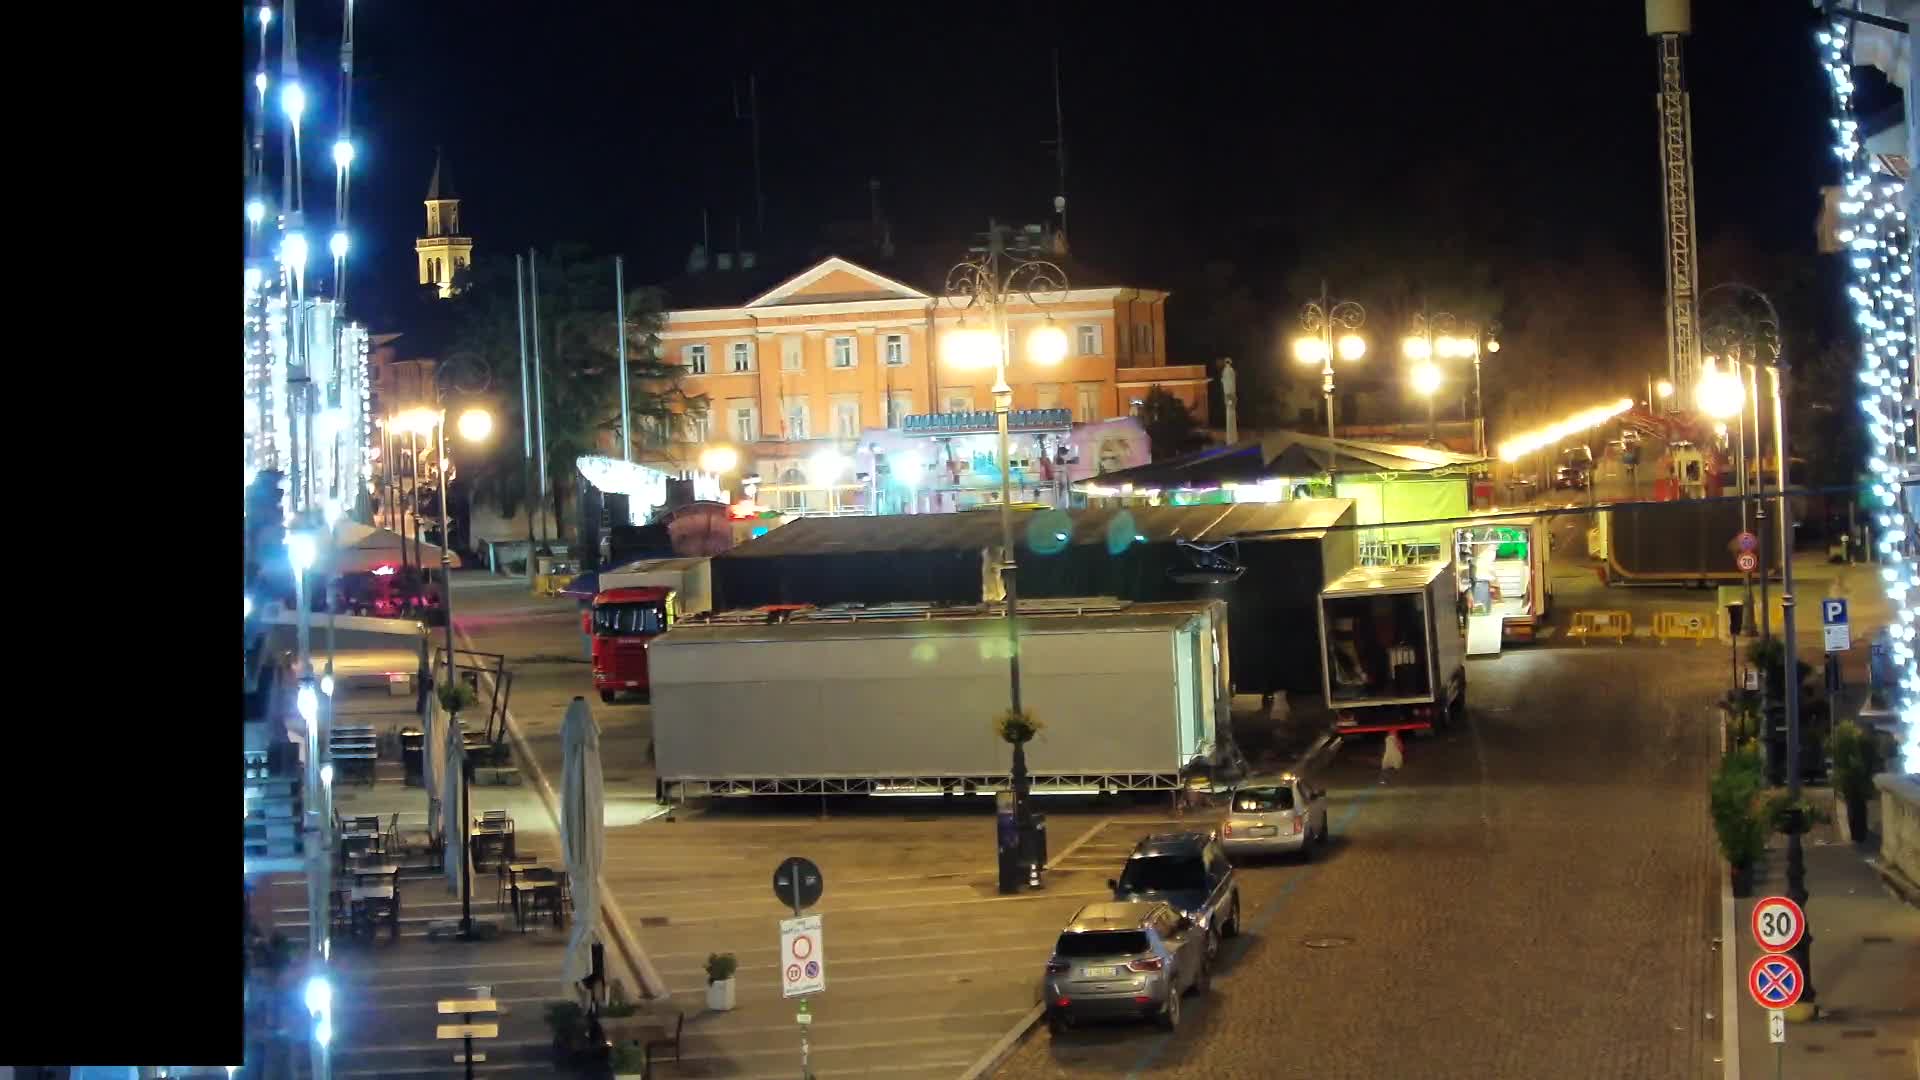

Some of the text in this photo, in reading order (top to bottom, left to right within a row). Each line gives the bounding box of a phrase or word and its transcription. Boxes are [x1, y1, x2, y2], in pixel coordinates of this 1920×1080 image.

[1742, 558, 1753, 567] 20
[1827, 602, 1842, 622] P
[1763, 912, 1791, 937] 30
